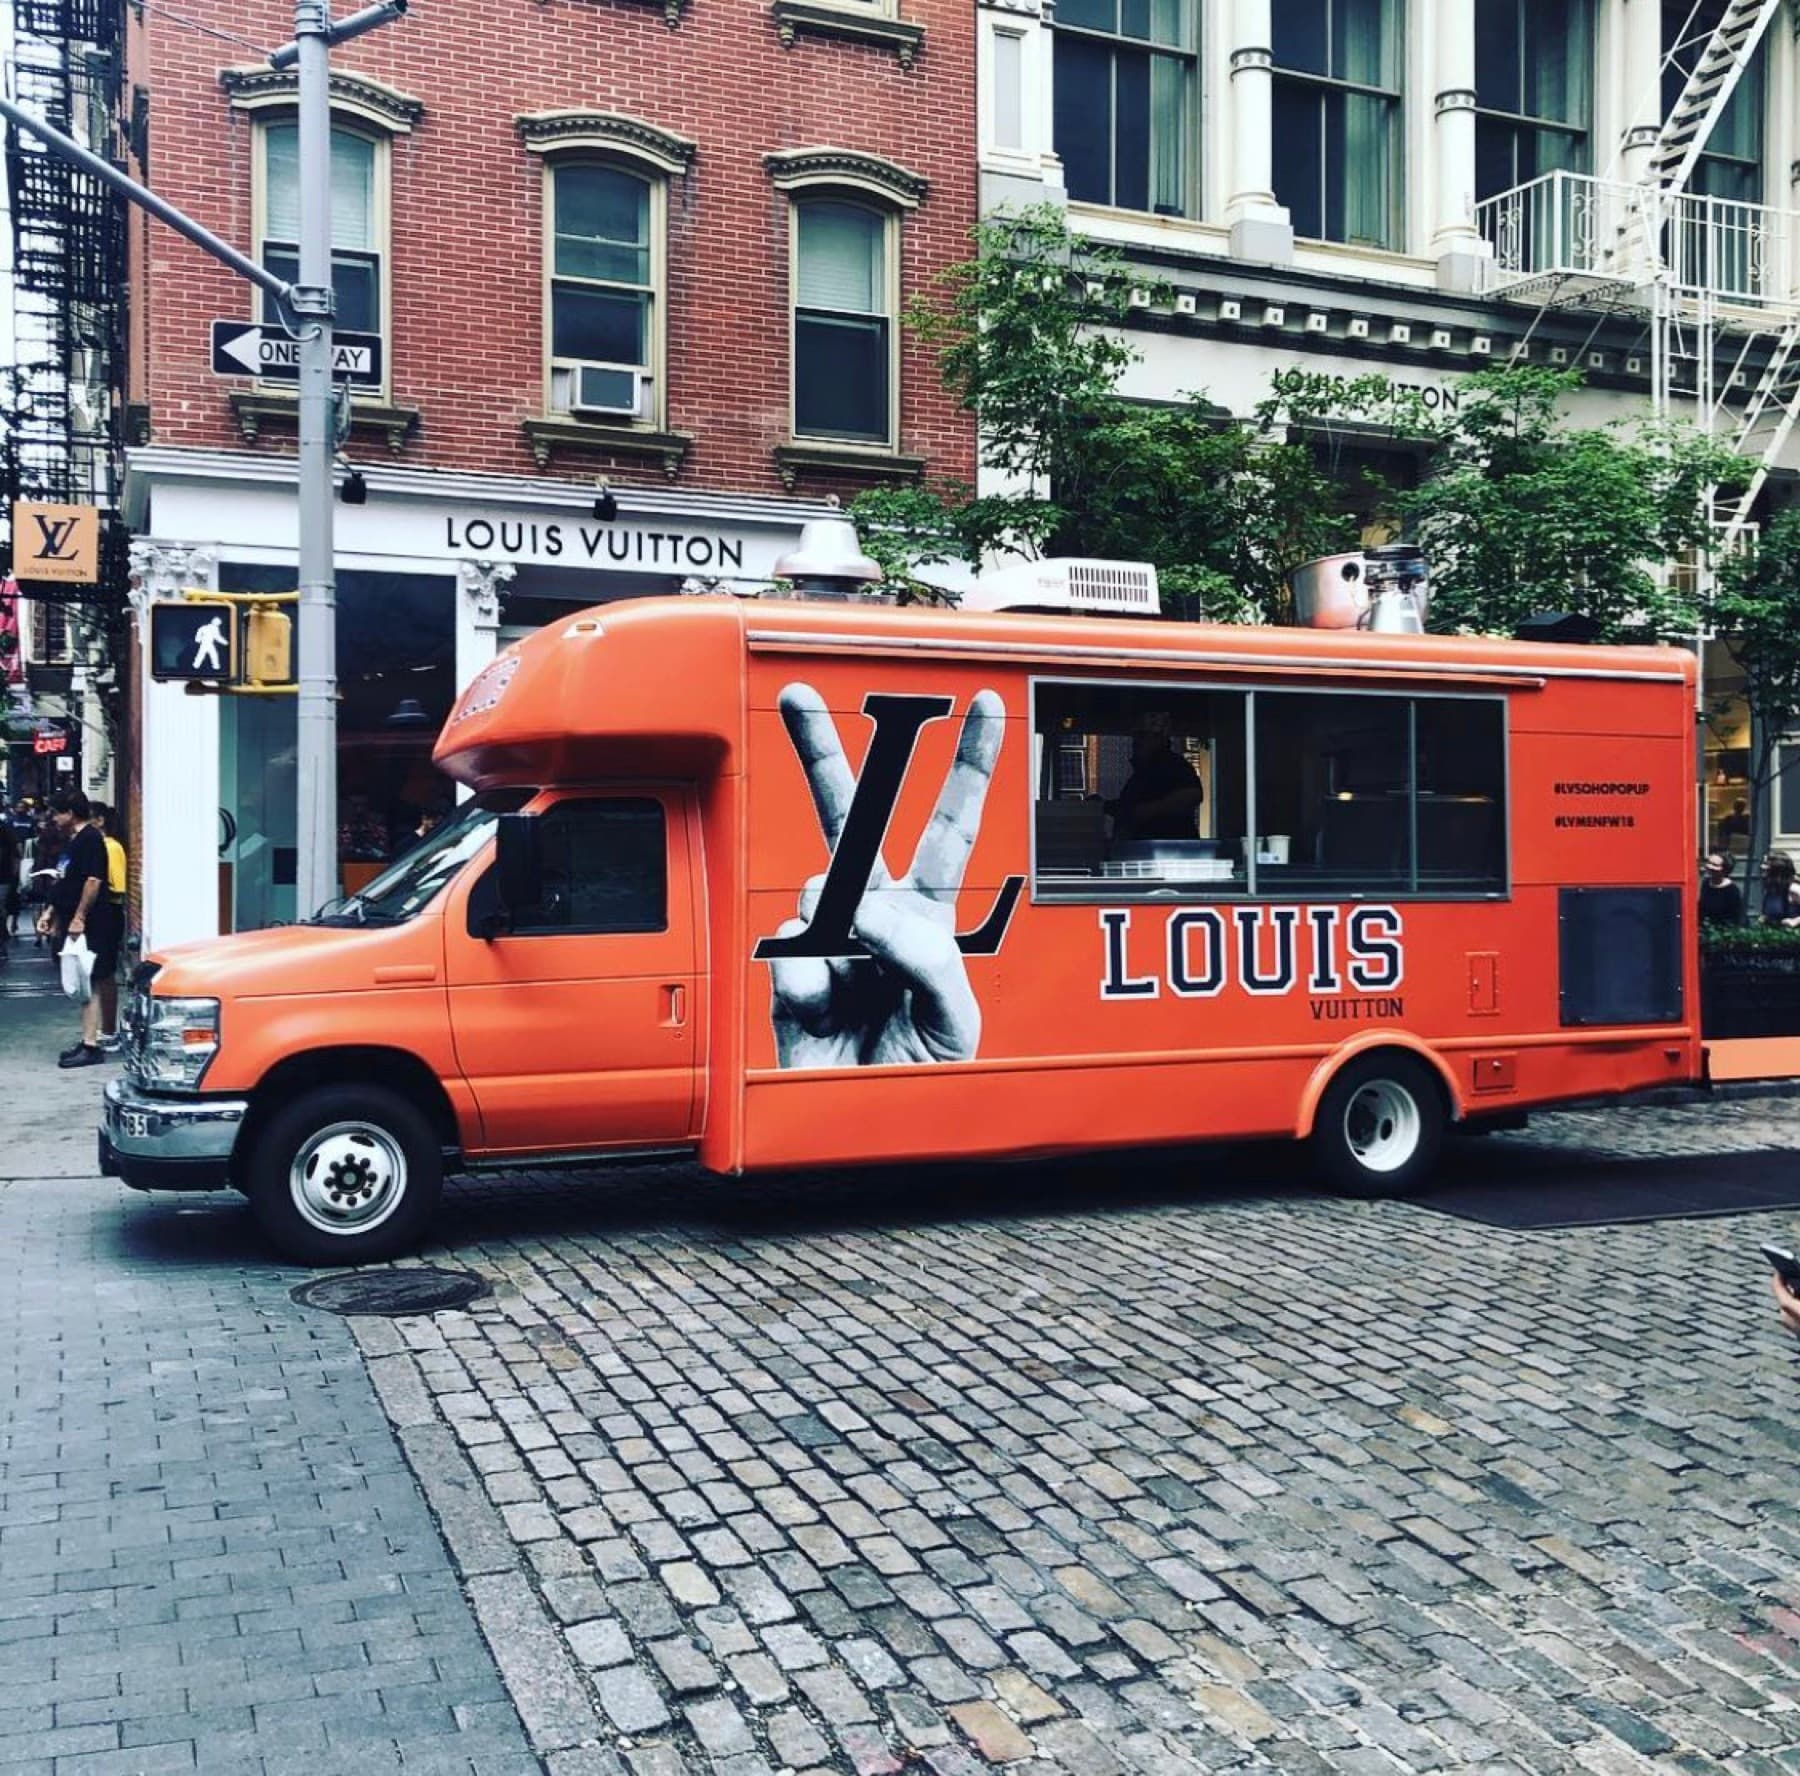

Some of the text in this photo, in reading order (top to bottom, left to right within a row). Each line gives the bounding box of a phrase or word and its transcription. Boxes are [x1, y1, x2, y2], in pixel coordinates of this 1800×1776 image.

[258, 341, 363, 369] ONE AY
[447, 517, 743, 568] LOUIS VUITTON
[1554, 783, 1649, 795] #LVSOHOPOPUP
[1554, 815, 1634, 828] #LVMENFW18
[1099, 905, 1403, 999] LOUIS
[1310, 998, 1404, 1020] VUITTON
